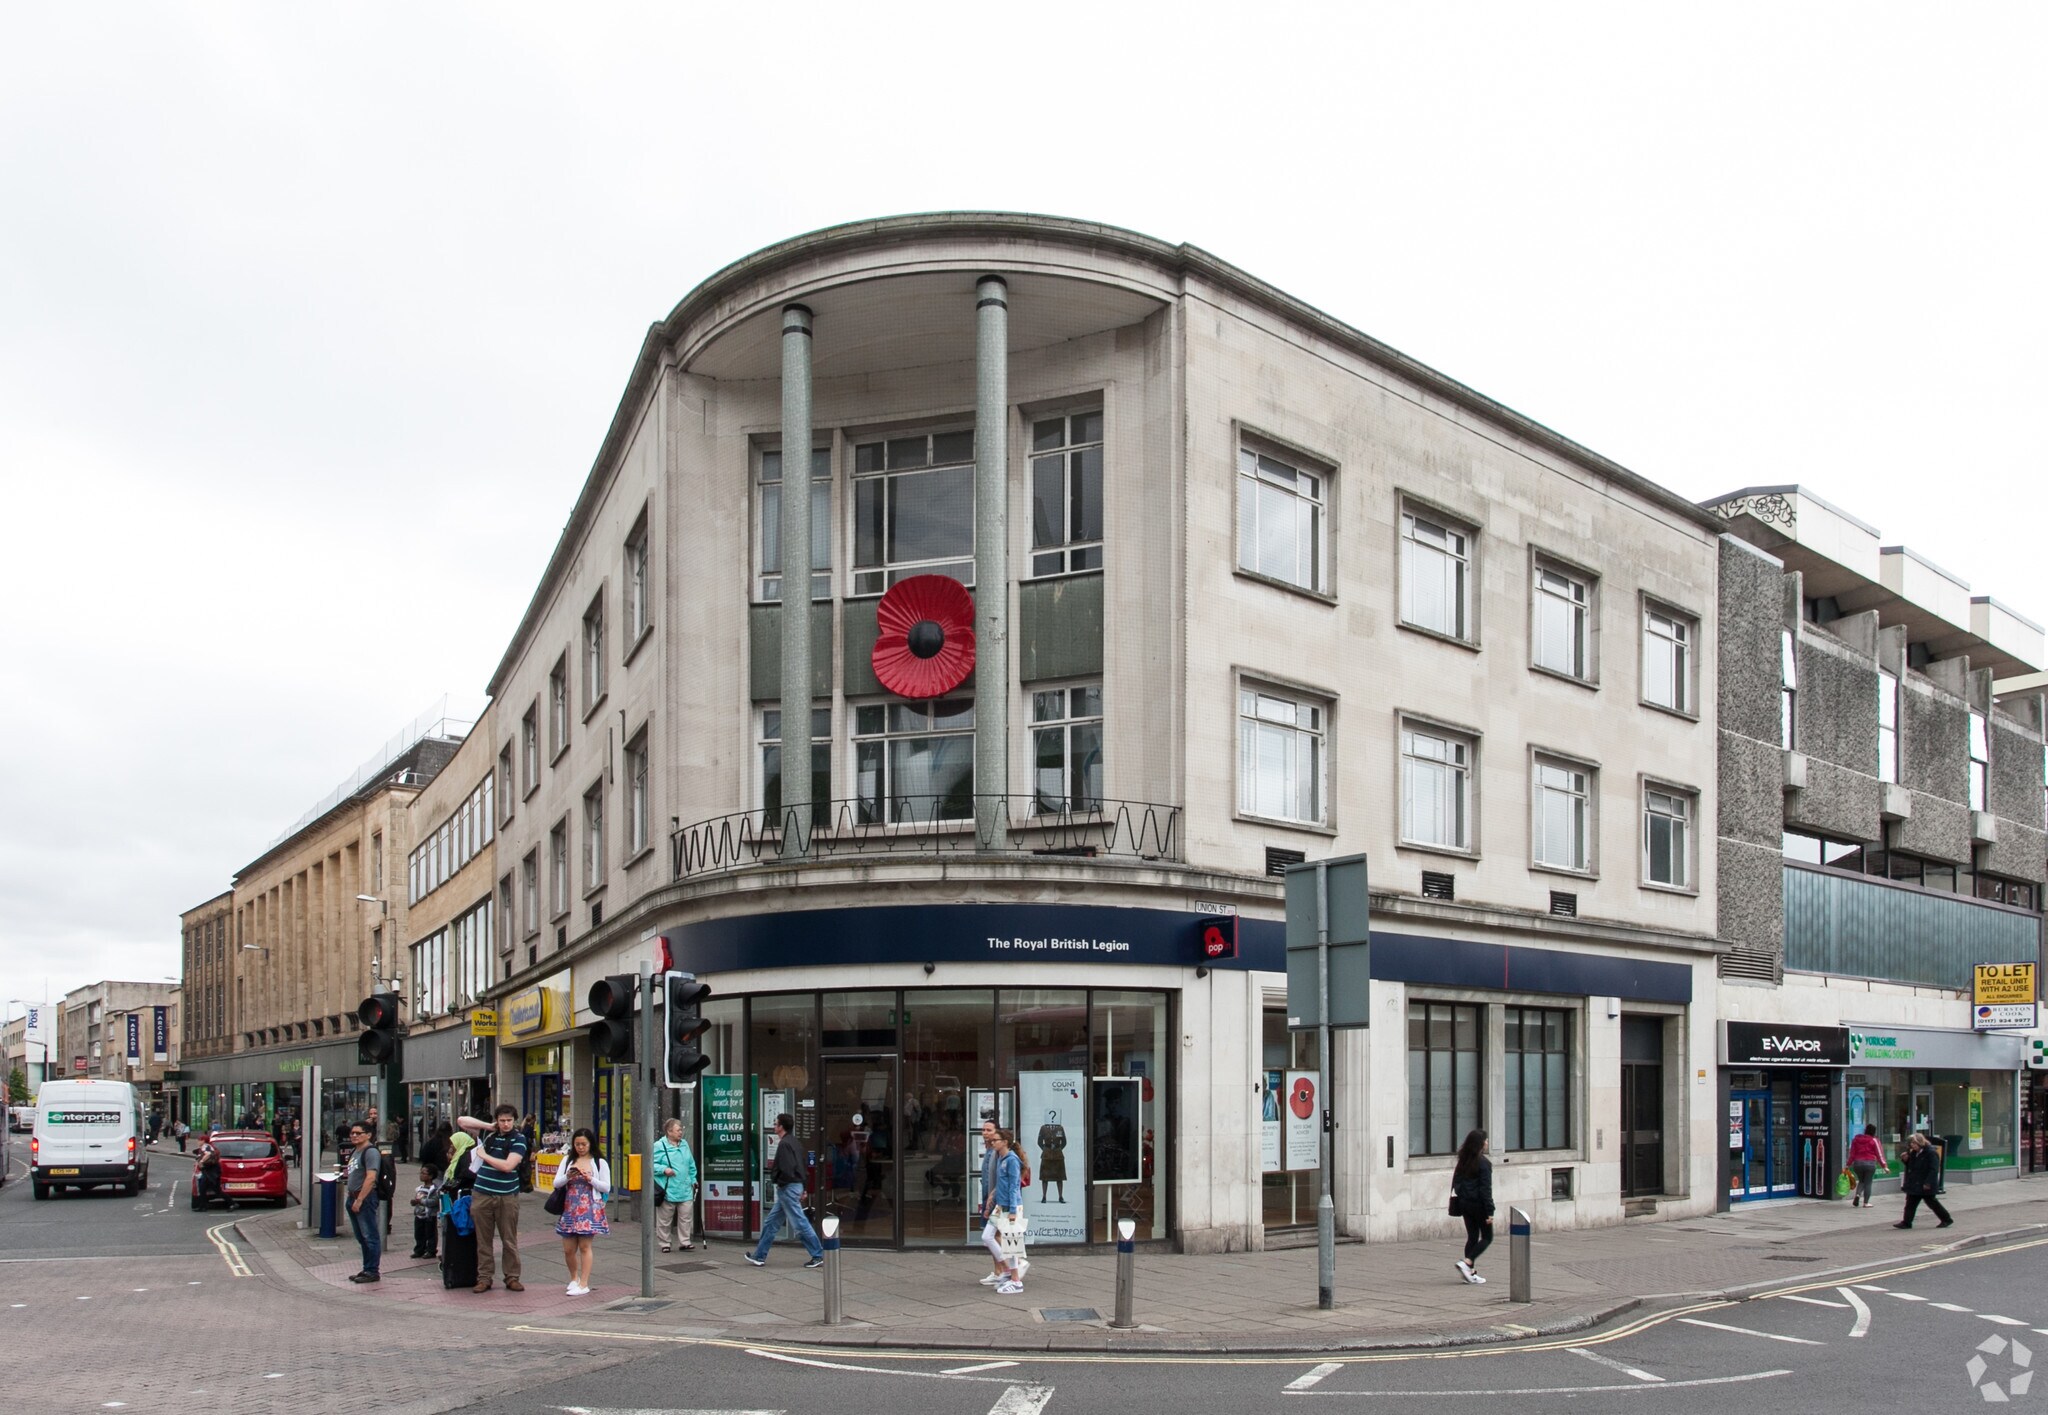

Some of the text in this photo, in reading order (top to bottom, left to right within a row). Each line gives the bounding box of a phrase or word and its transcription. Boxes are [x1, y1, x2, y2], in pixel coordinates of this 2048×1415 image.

[1198, 902, 1217, 913] UNION
[1219, 905, 1227, 914] ST
[987, 938, 1130, 952] The Royal British Legion
[1208, 943, 1224, 954] pop
[1978, 964, 2032, 978] TO LET
[28, 1008, 38, 1029] Post
[1865, 1036, 1897, 1047] YORKSHIRE
[1865, 1049, 1915, 1059] BUILDING SOCIETY
[714, 1088, 726, 1096] Join
[49, 1112, 120, 1122] enterprise
[707, 1123, 755, 1131] BREAKFAT
[720, 1134, 742, 1142] CLUB
